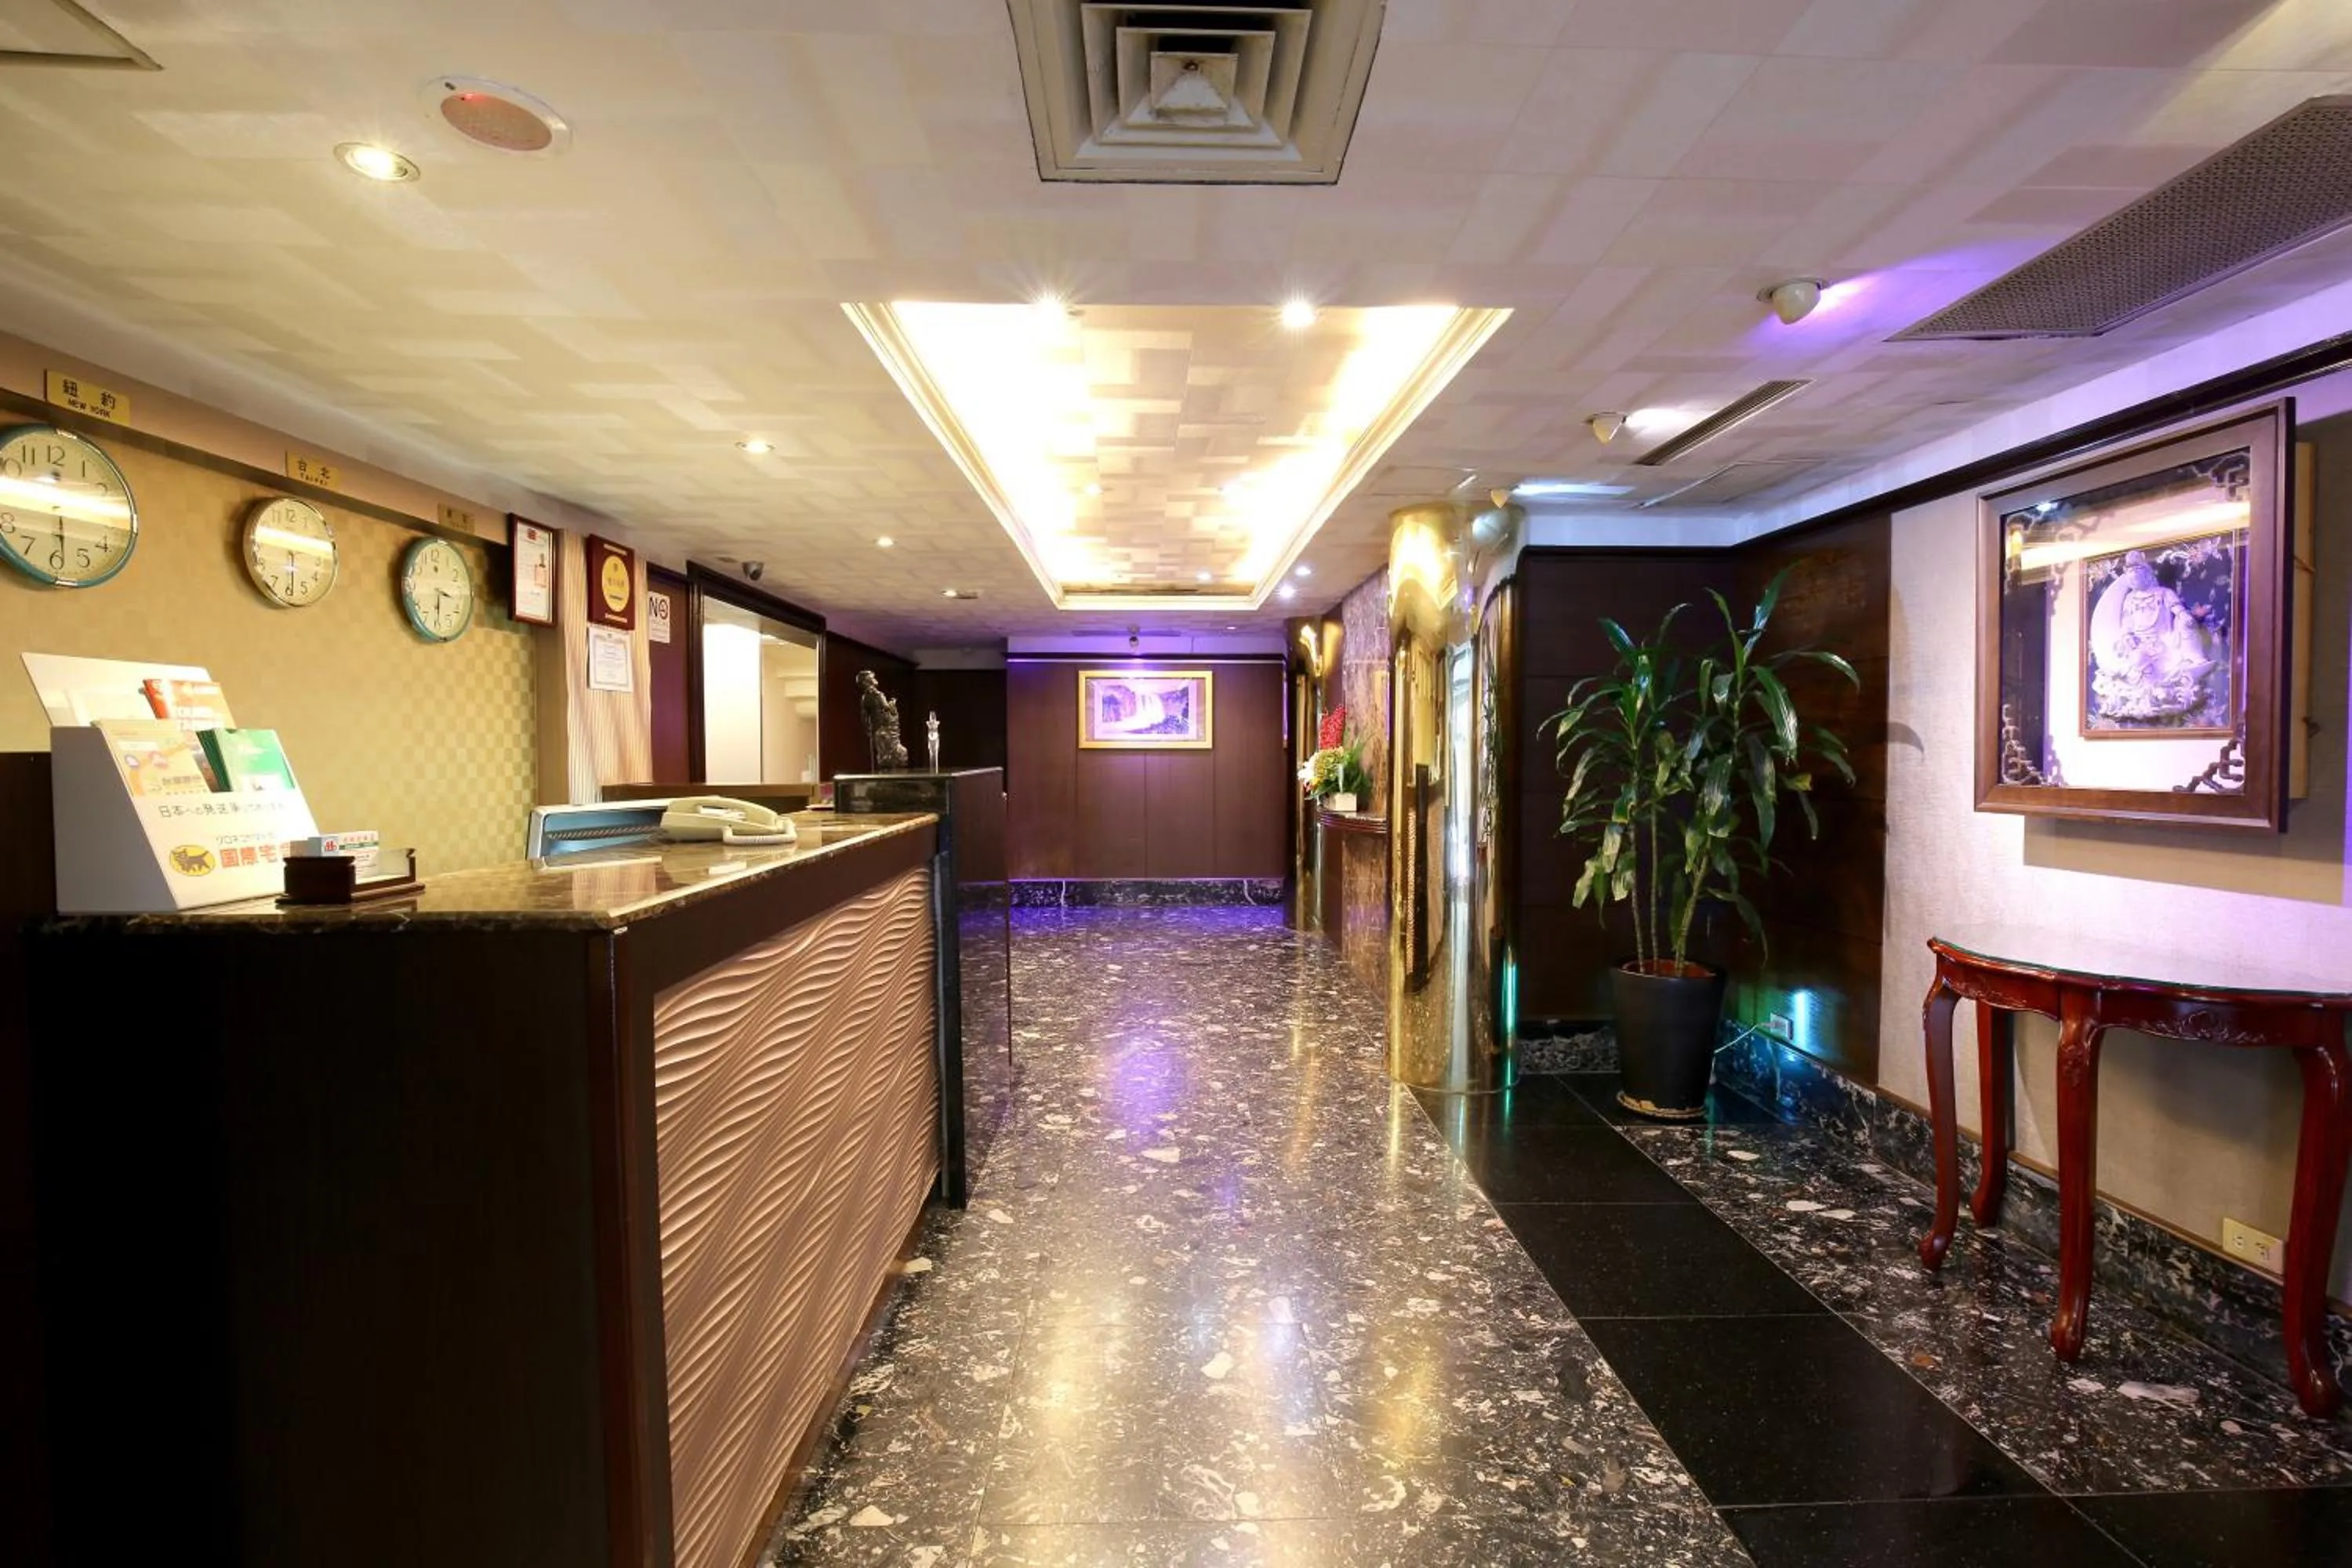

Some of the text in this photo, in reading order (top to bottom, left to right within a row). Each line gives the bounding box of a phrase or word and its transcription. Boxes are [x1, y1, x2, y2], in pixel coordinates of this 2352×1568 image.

[22, 444, 35, 465] 11
[47, 445, 66, 466] 12
[20, 535, 36, 556] 7
[76, 548, 91, 568] 5
